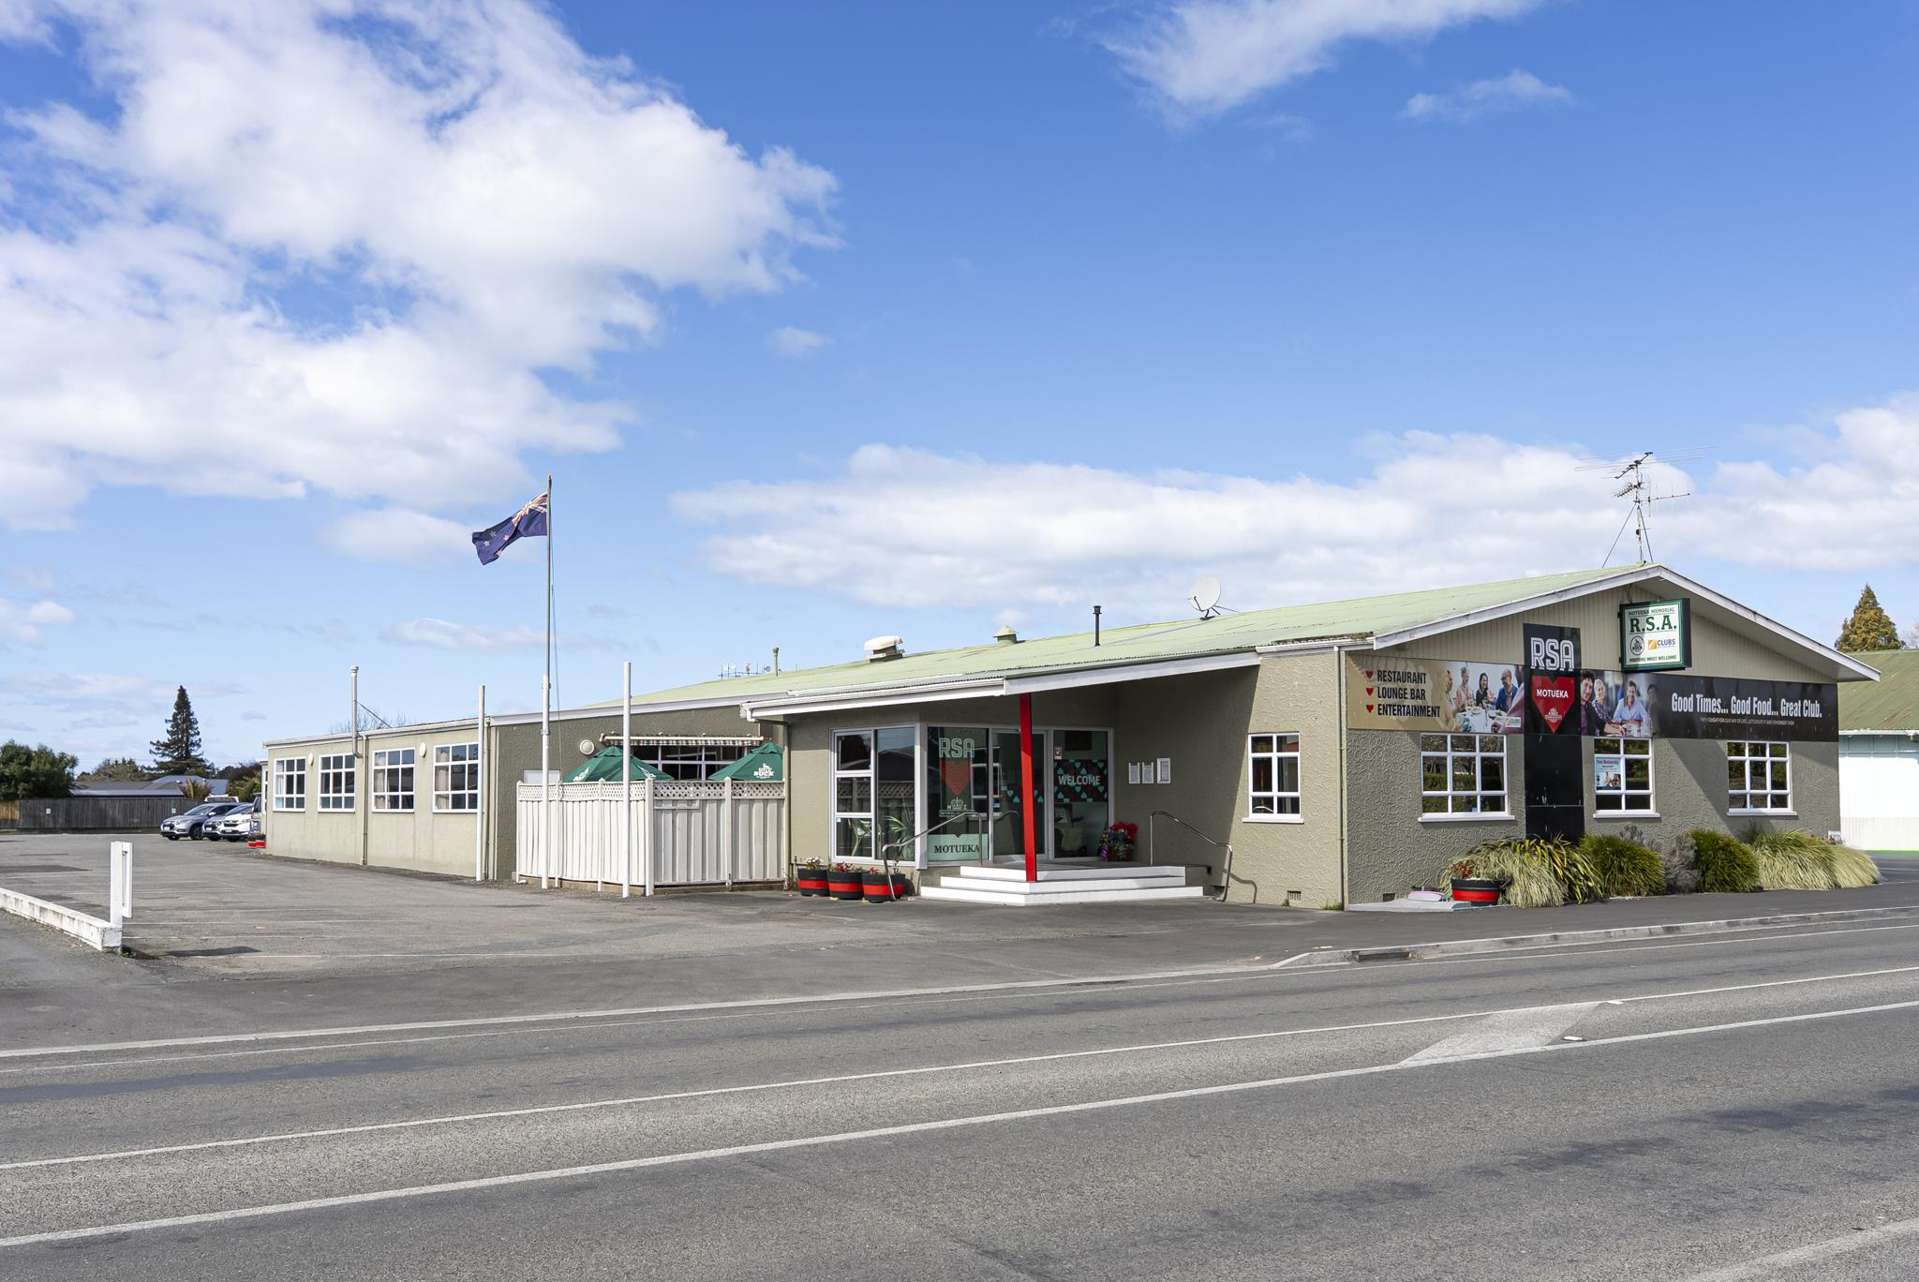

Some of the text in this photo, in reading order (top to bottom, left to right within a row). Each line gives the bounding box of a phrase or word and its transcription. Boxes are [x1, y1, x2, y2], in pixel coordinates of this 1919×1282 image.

[1630, 615, 1677, 633] R.S.A.
[1530, 637, 1574, 671] RSA
[1377, 670, 1426, 684] RESTAURANT
[1377, 687, 1426, 700] LOUNGE BAR
[1536, 688, 1569, 698] MOTUEKA
[1377, 703, 1440, 717] ENTERTAINMENT
[1671, 692, 1694, 712] Good
[1731, 695, 1750, 714] Good
[1780, 698, 1801, 717] Great
[1803, 699, 1823, 718] Club.
[939, 738, 976, 758] RSA
[1058, 775, 1101, 785] WELCOME
[934, 844, 980, 854] MOTUEKA
